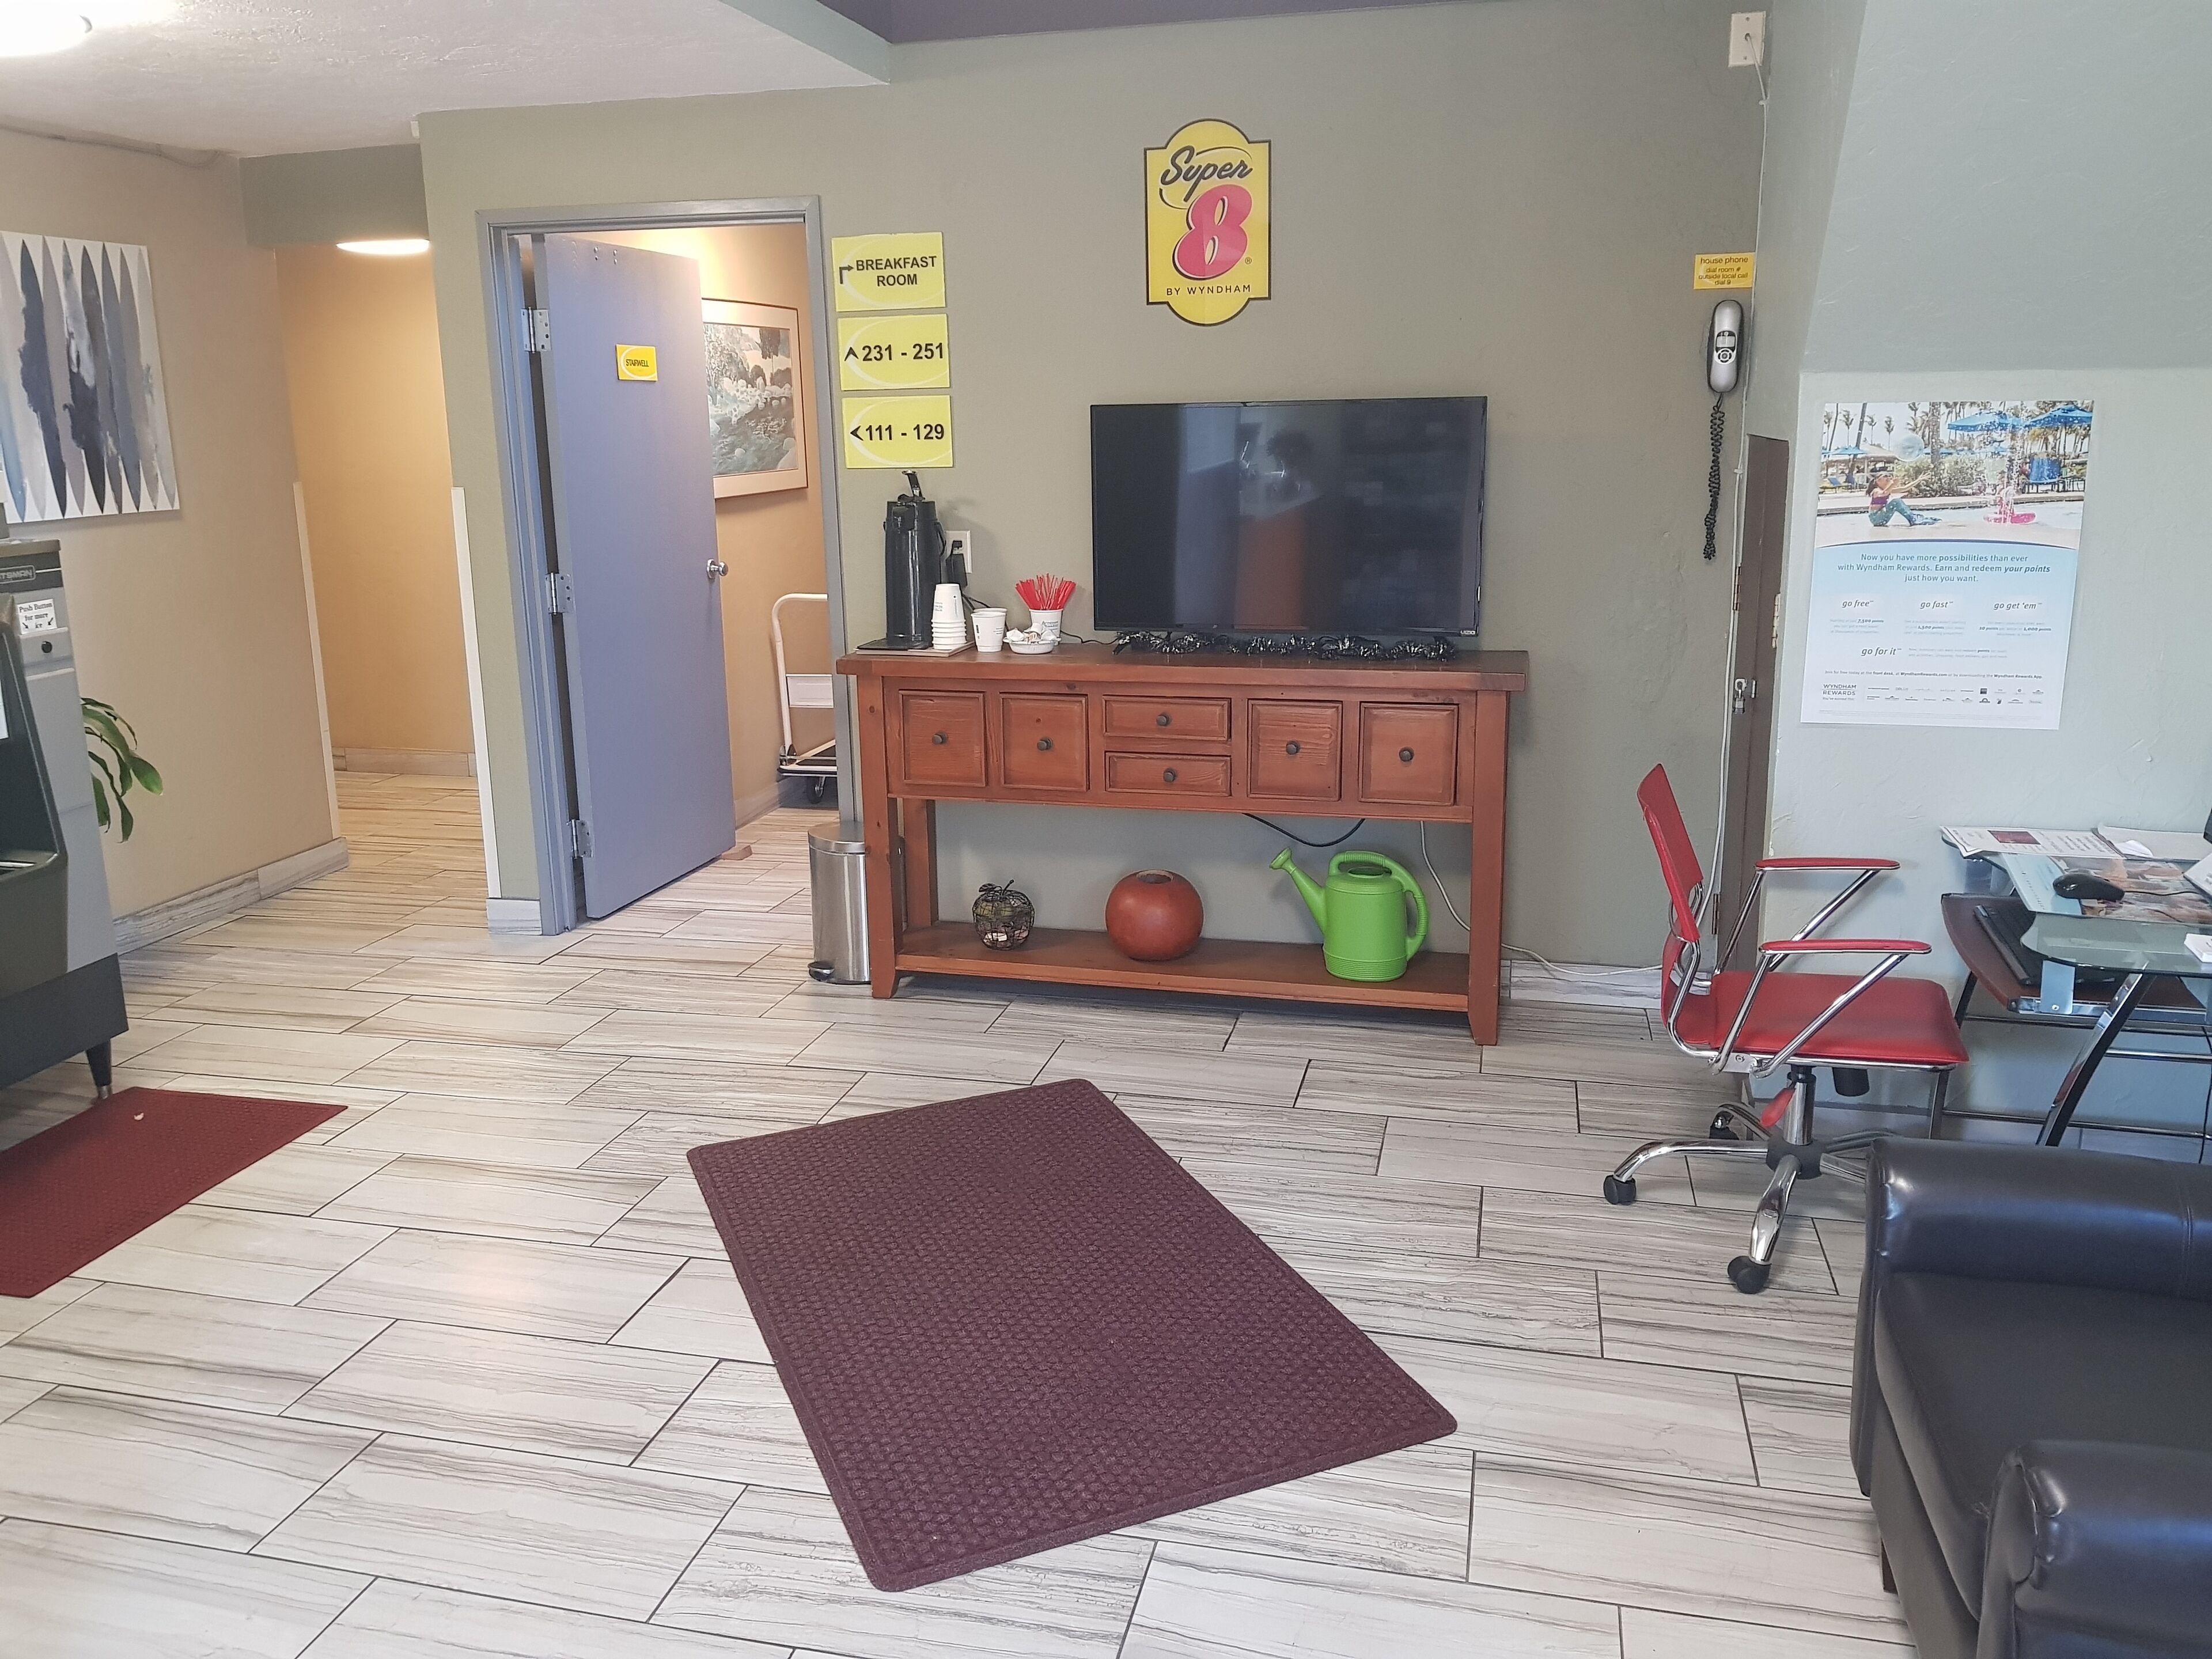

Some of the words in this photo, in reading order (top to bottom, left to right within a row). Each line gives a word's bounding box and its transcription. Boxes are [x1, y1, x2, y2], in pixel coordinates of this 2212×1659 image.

[1161, 145, 1253, 202] Super
[1172, 184, 1253, 281] 8
[856, 256, 937, 271] BREAKFAST
[1725, 256, 1748, 265] phone
[877, 274, 917, 286] ROOM
[1166, 287, 1180, 296] BY
[1187, 285, 1251, 295] WYNDHAM
[862, 344, 893, 362] 231
[912, 343, 944, 360] 251
[865, 425, 893, 441] 111
[913, 424, 945, 440] 129
[1939, 554, 1988, 562] possibilities
[0, 569, 32, 579] TSMAN
[2024, 565, 2050, 573] points
[1861, 648, 1873, 656] go
[1874, 647, 1888, 657] for
